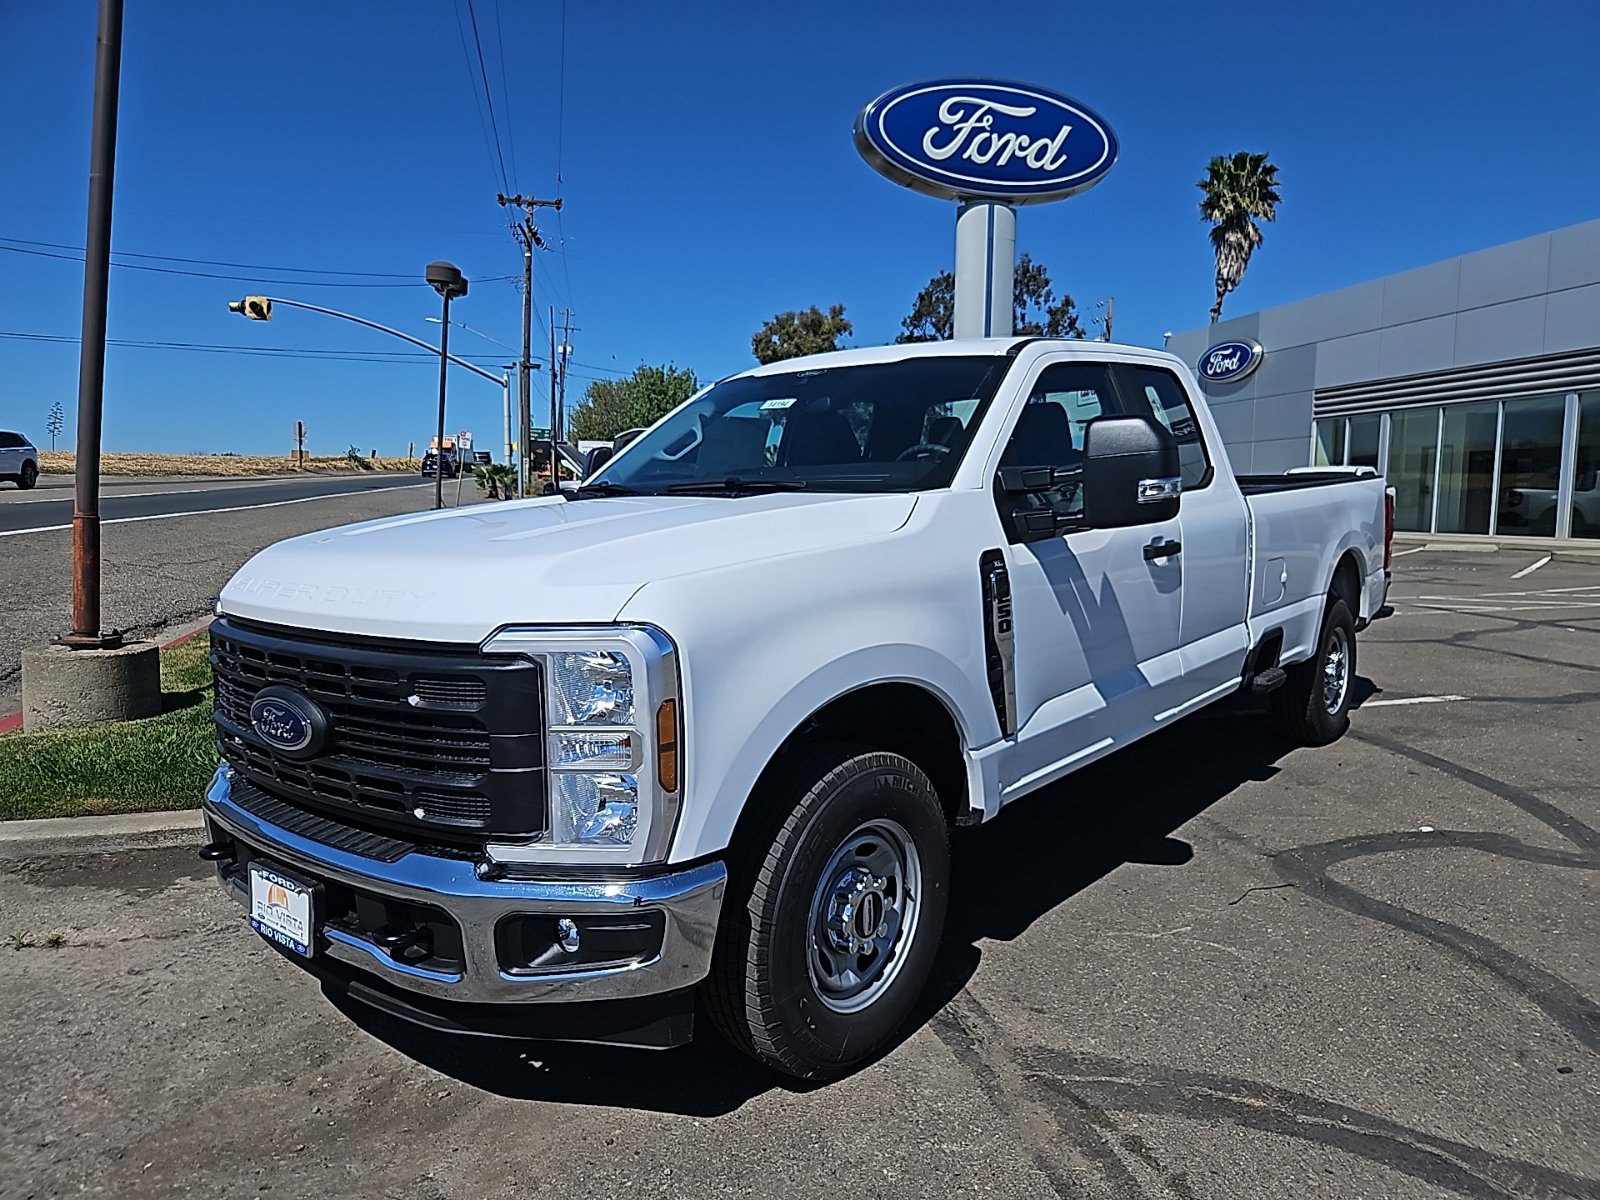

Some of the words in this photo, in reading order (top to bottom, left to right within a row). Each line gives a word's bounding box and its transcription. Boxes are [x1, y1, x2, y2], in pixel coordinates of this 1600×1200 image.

[922, 95, 1072, 171] Ford
[1207, 347, 1241, 375] Ford
[231, 576, 319, 601] SUPER
[320, 585, 437, 611] DUTY
[261, 706, 294, 739] Ford
[262, 871, 295, 890] FORD
[257, 900, 274, 916] RIO
[275, 909, 304, 932] VISTA
[260, 923, 273, 938] RIO
[274, 931, 296, 950] VISTA
